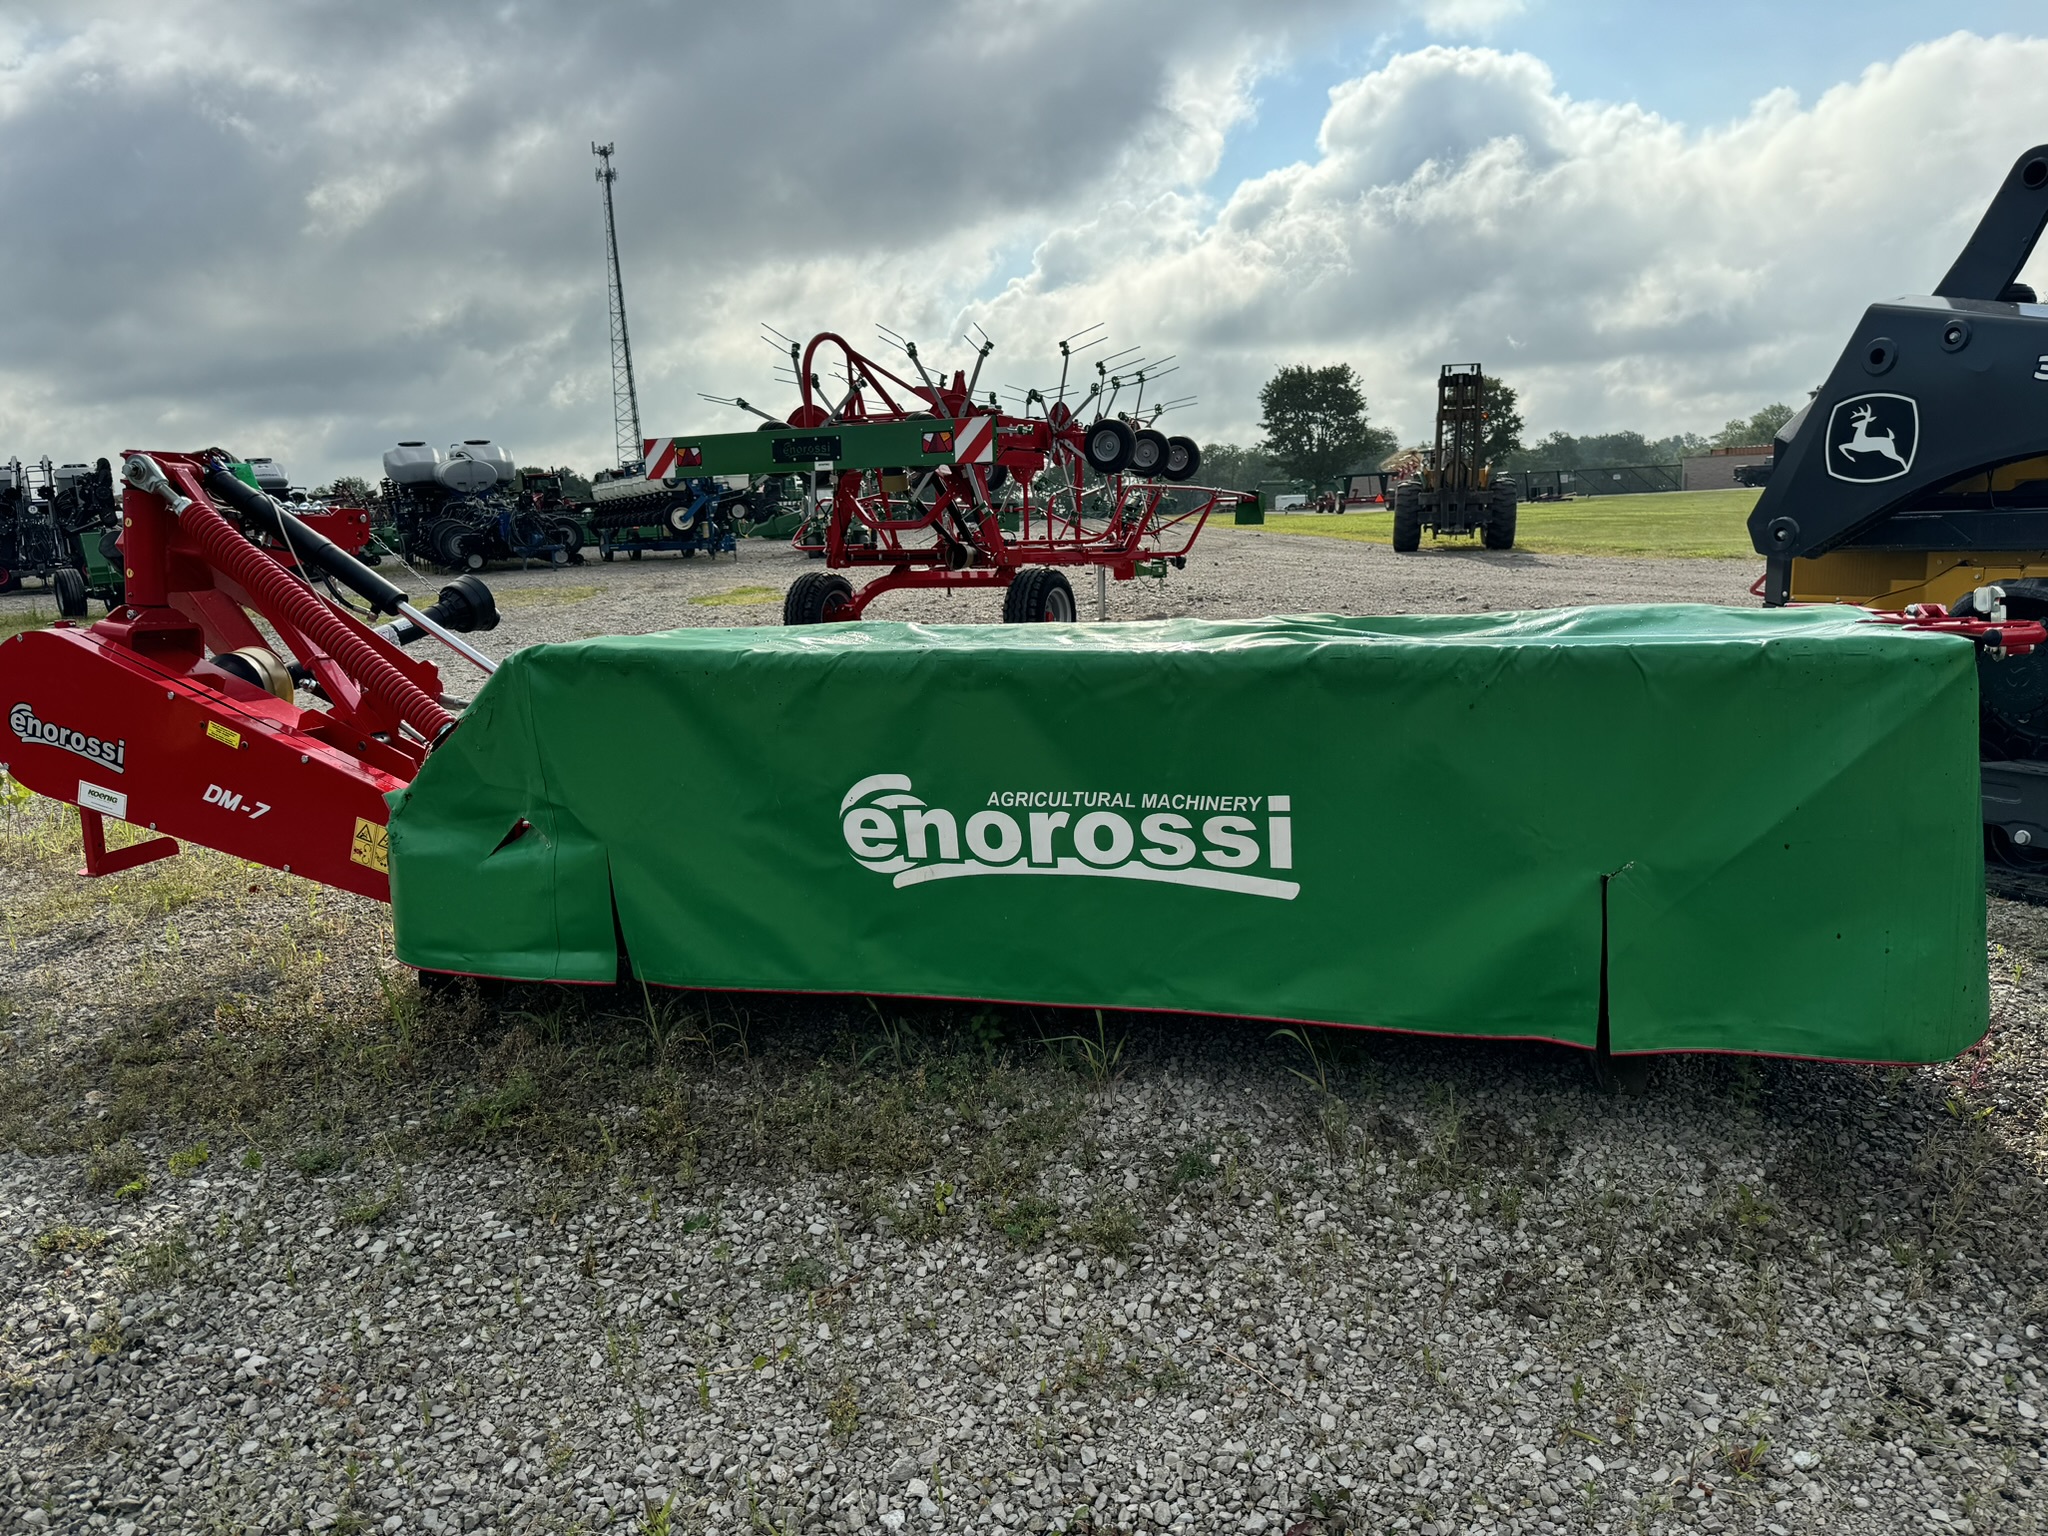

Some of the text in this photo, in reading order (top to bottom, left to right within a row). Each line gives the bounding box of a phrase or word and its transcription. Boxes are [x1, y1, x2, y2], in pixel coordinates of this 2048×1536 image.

[782, 442, 831, 456] enorossi
[10, 711, 125, 766] enorossi
[202, 784, 271, 819] DM-7
[987, 791, 1262, 811] AGRICULTURAL MACHINERY
[843, 795, 1293, 871] enorossi
